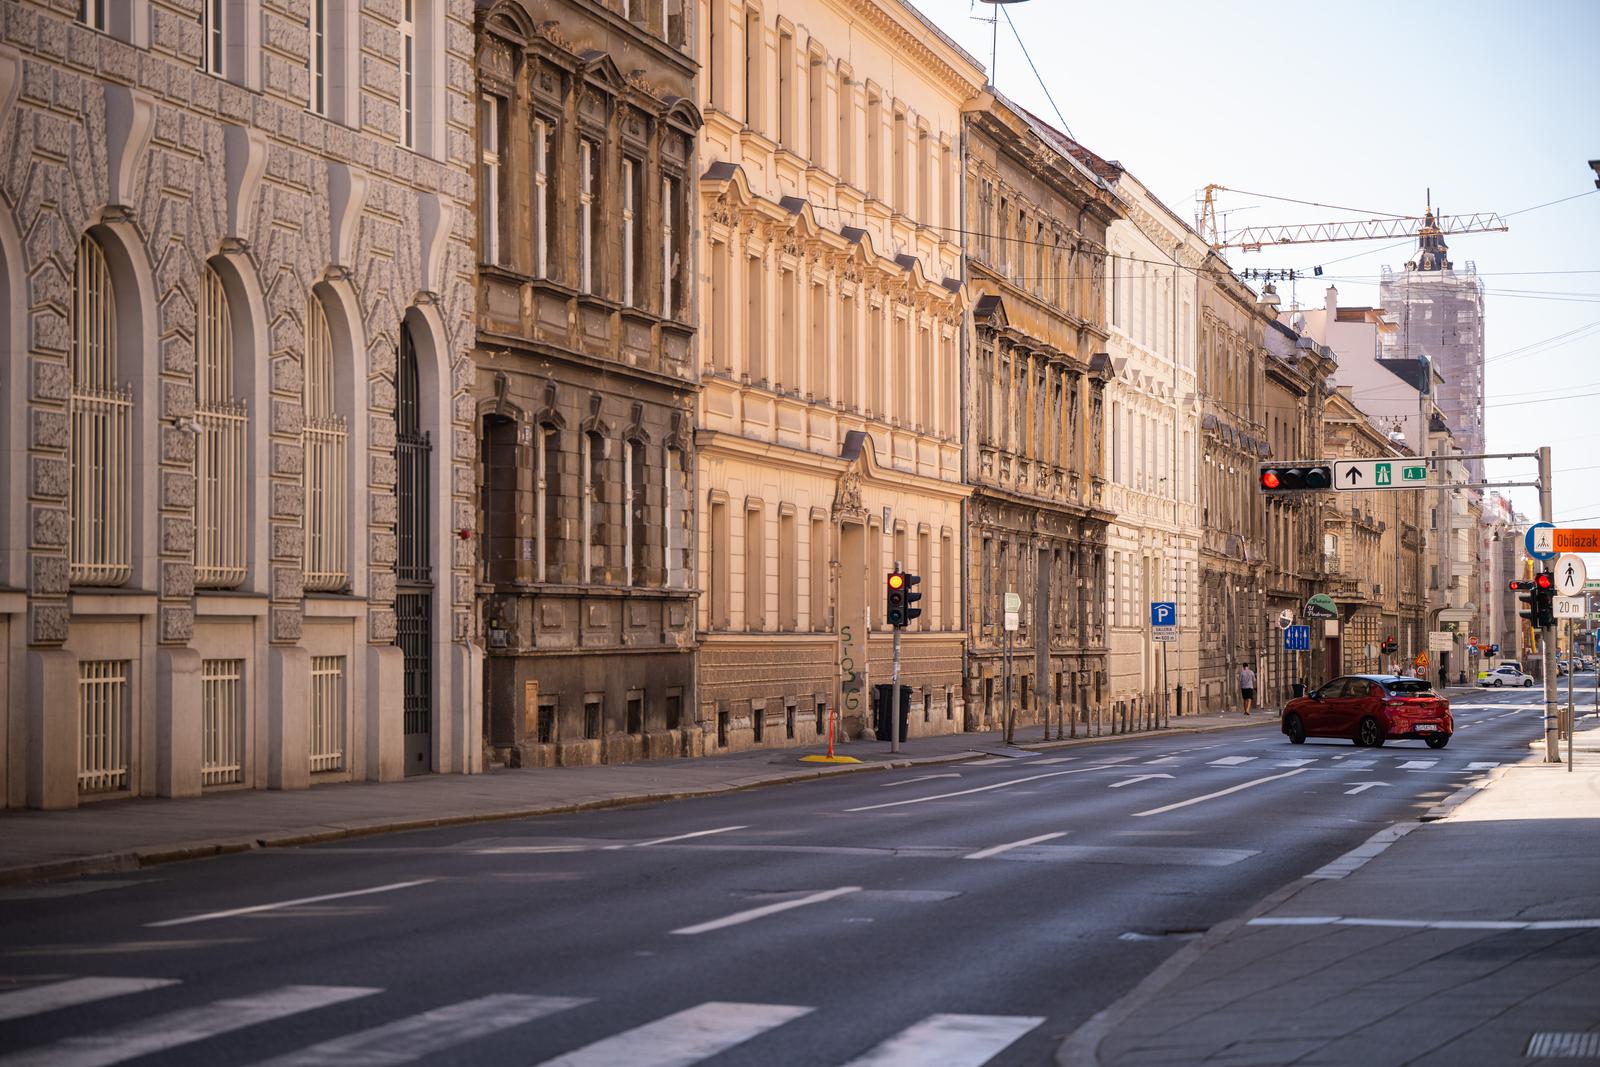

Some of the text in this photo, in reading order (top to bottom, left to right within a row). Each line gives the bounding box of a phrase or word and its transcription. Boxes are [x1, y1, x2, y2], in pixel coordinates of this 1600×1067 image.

[1407, 468, 1413, 478] A
[1557, 534, 1598, 547] Obilazak
[1559, 601, 1579, 613] 20 m
[1158, 608, 1168, 622] P
